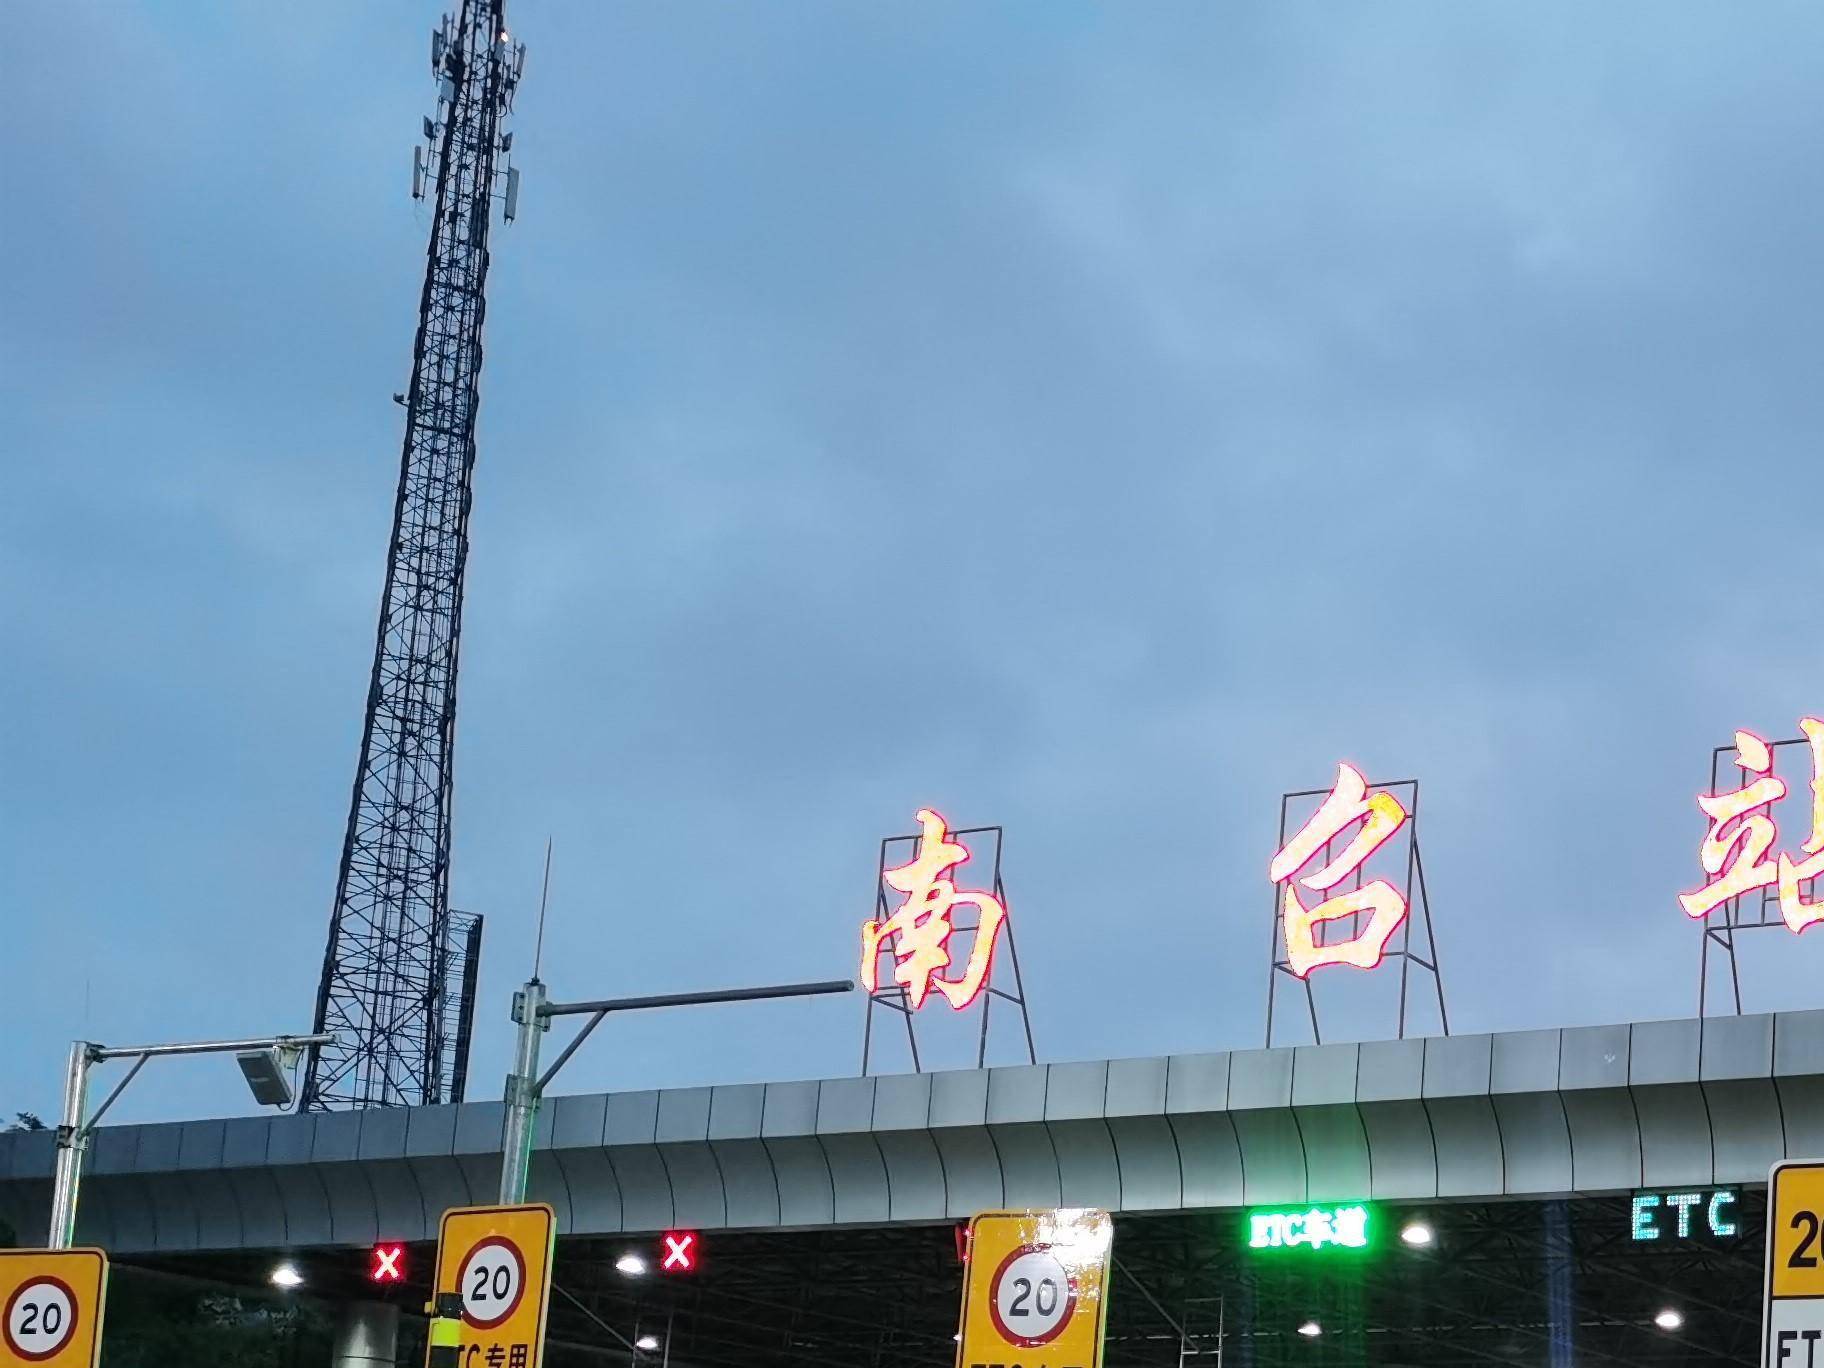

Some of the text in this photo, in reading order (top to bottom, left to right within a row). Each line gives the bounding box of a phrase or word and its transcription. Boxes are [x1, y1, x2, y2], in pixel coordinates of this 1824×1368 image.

[1631, 1191, 1737, 1240] ETC
[470, 1265, 512, 1301] 20
[1008, 1277, 1059, 1318] 20
[18, 1303, 63, 1336] 20
